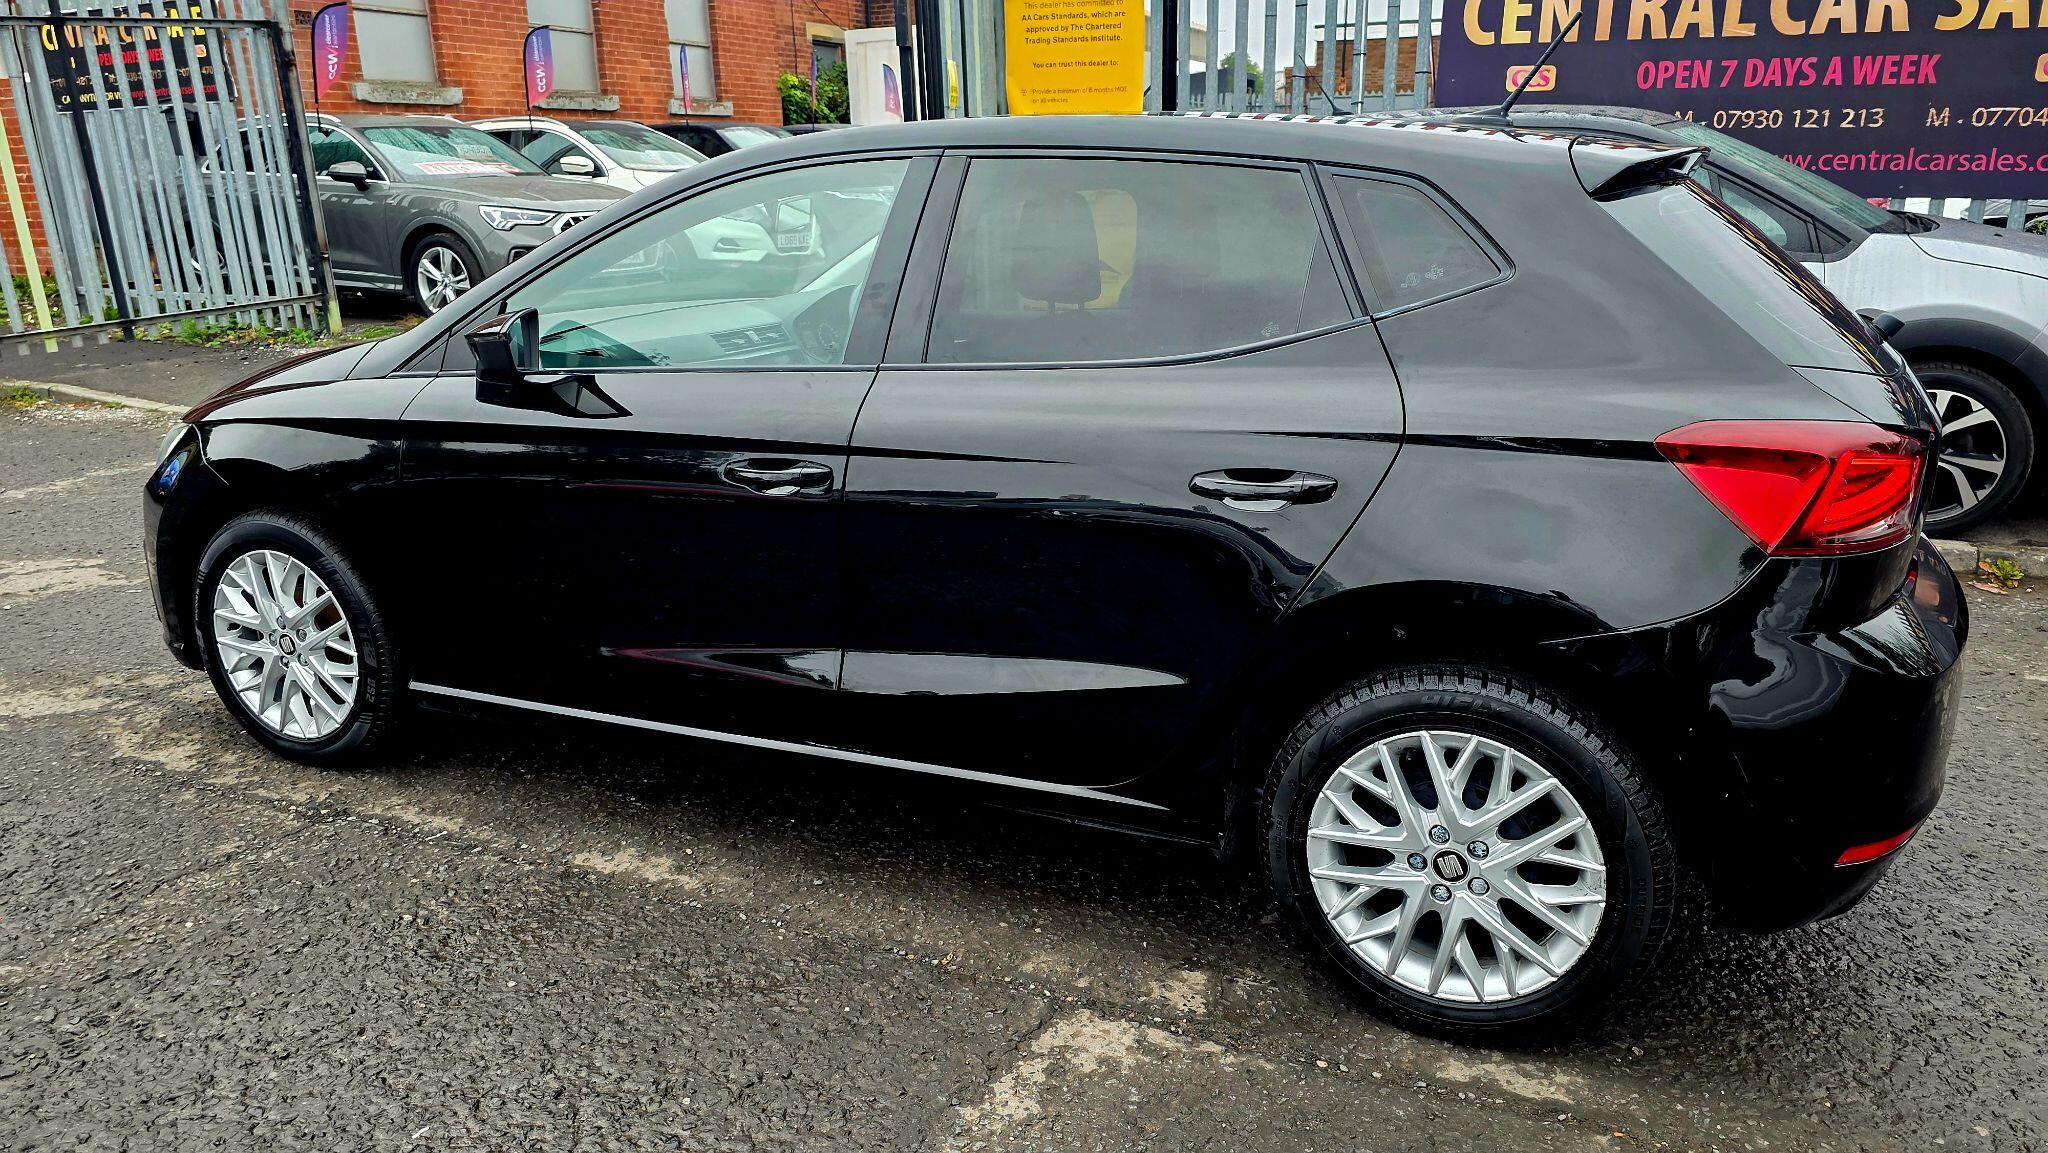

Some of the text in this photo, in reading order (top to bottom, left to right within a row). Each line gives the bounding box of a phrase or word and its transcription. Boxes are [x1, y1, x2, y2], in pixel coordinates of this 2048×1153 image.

[1024, 2, 1039, 10] This
[1040, 1, 1061, 9] dealer
[1063, 0, 1075, 8] has
[1033, 13, 1050, 21] Cars
[1051, 11, 1090, 20] Standards,
[1091, 10, 1113, 18] which
[1025, 22, 1122, 34] approved by The Chartered
[1024, 34, 1123, 45] Trading Standards Institute.
[1636, 53, 1942, 90] OPEN 7 DAYS A WEEK
[1713, 109, 1784, 129] 07930
[1792, 108, 1831, 129] 121
[1839, 107, 1886, 129] 213
[1971, 106, 2048, 127] 07704
